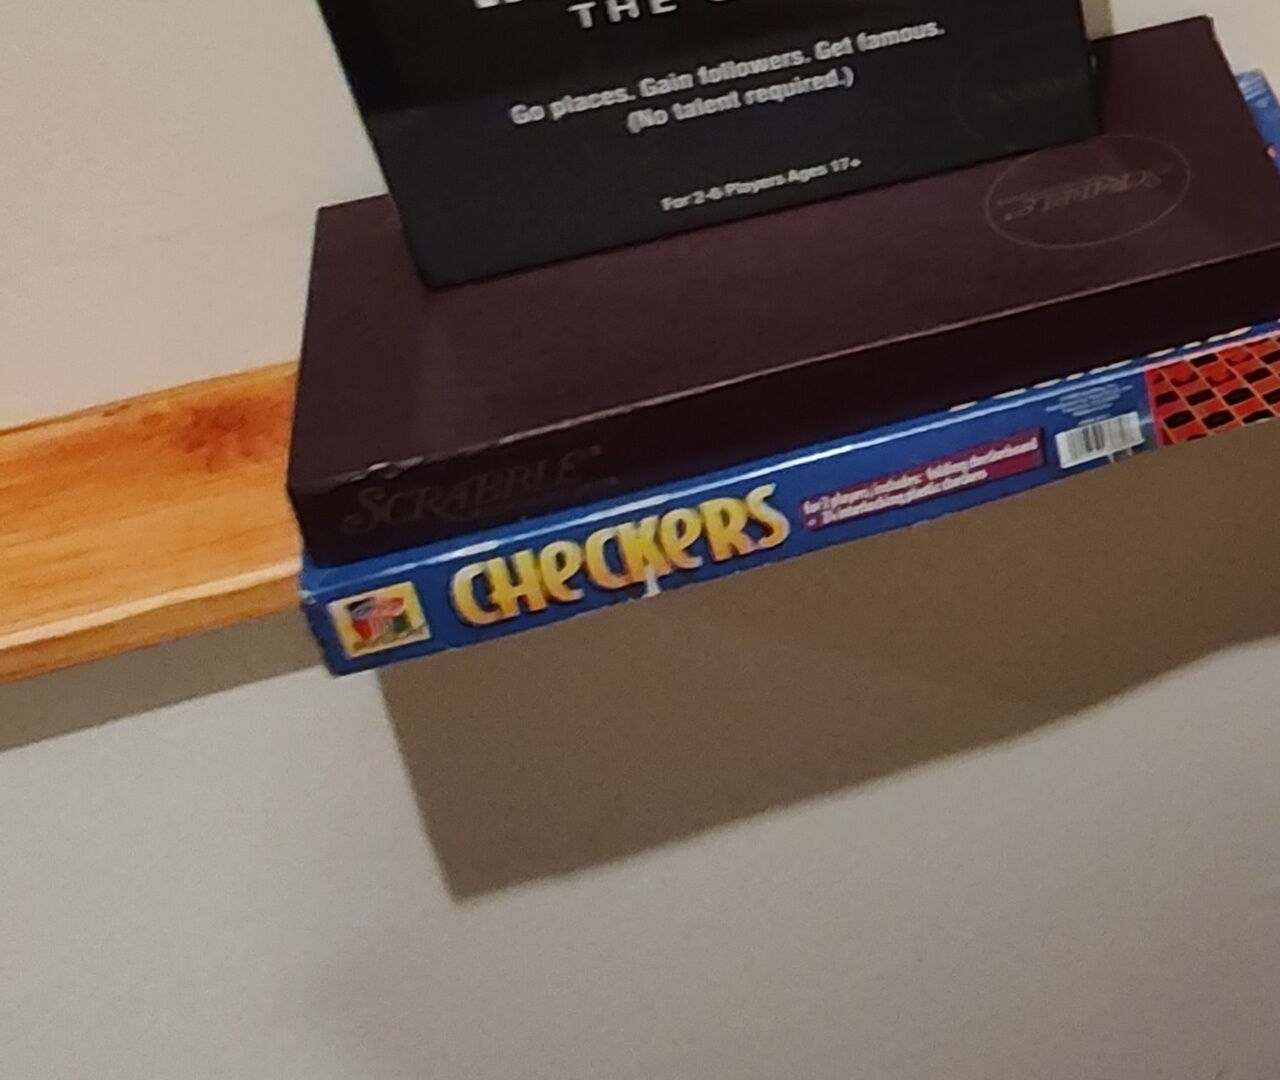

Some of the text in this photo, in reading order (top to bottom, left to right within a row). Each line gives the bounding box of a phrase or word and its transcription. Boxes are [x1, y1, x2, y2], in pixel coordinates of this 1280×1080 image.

[510, 22, 946, 125] Go places. Gain followers. Get famous.
[627, 66, 855, 133] (No talent required.)
[660, 195, 689, 211] For
[725, 172, 786, 197] Players
[787, 163, 827, 185] Ages
[830, 156, 862, 173] 17+
